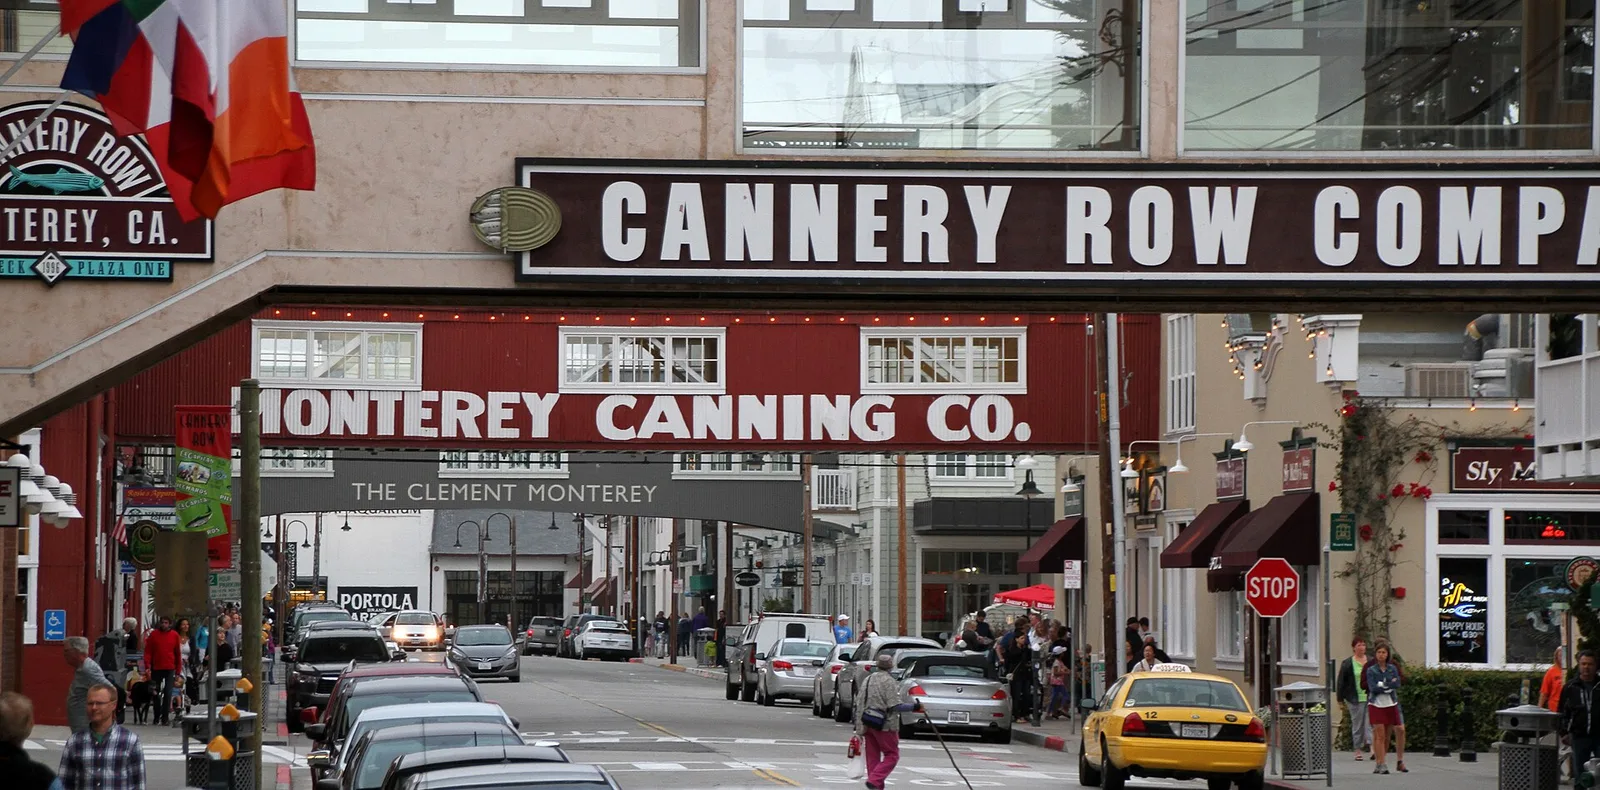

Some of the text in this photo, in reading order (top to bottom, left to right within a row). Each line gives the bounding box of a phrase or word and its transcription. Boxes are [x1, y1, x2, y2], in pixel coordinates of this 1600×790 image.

[0, 117, 152, 192] NERY ROW
[4, 208, 179, 248] TEREY, CA.
[602, 181, 1012, 263] CANNERY
[1066, 185, 1258, 266] ROW
[78, 261, 125, 276] PLAZA
[134, 262, 165, 276] ONE
[180, 413, 228, 428] CANNERY
[231, 387, 1031, 441] MONTEREY CANNING CO.
[192, 431, 216, 447] ROW
[1466, 460, 1502, 485] Sly
[352, 483, 658, 502] THE CLEMENT MONTEREY
[210, 574, 216, 585] 2
[1249, 576, 1295, 599] STOP
[340, 593, 414, 610] PORTOLA
[1441, 621, 1485, 631] HAPPY HOUR
[1145, 711, 1158, 719] 12
